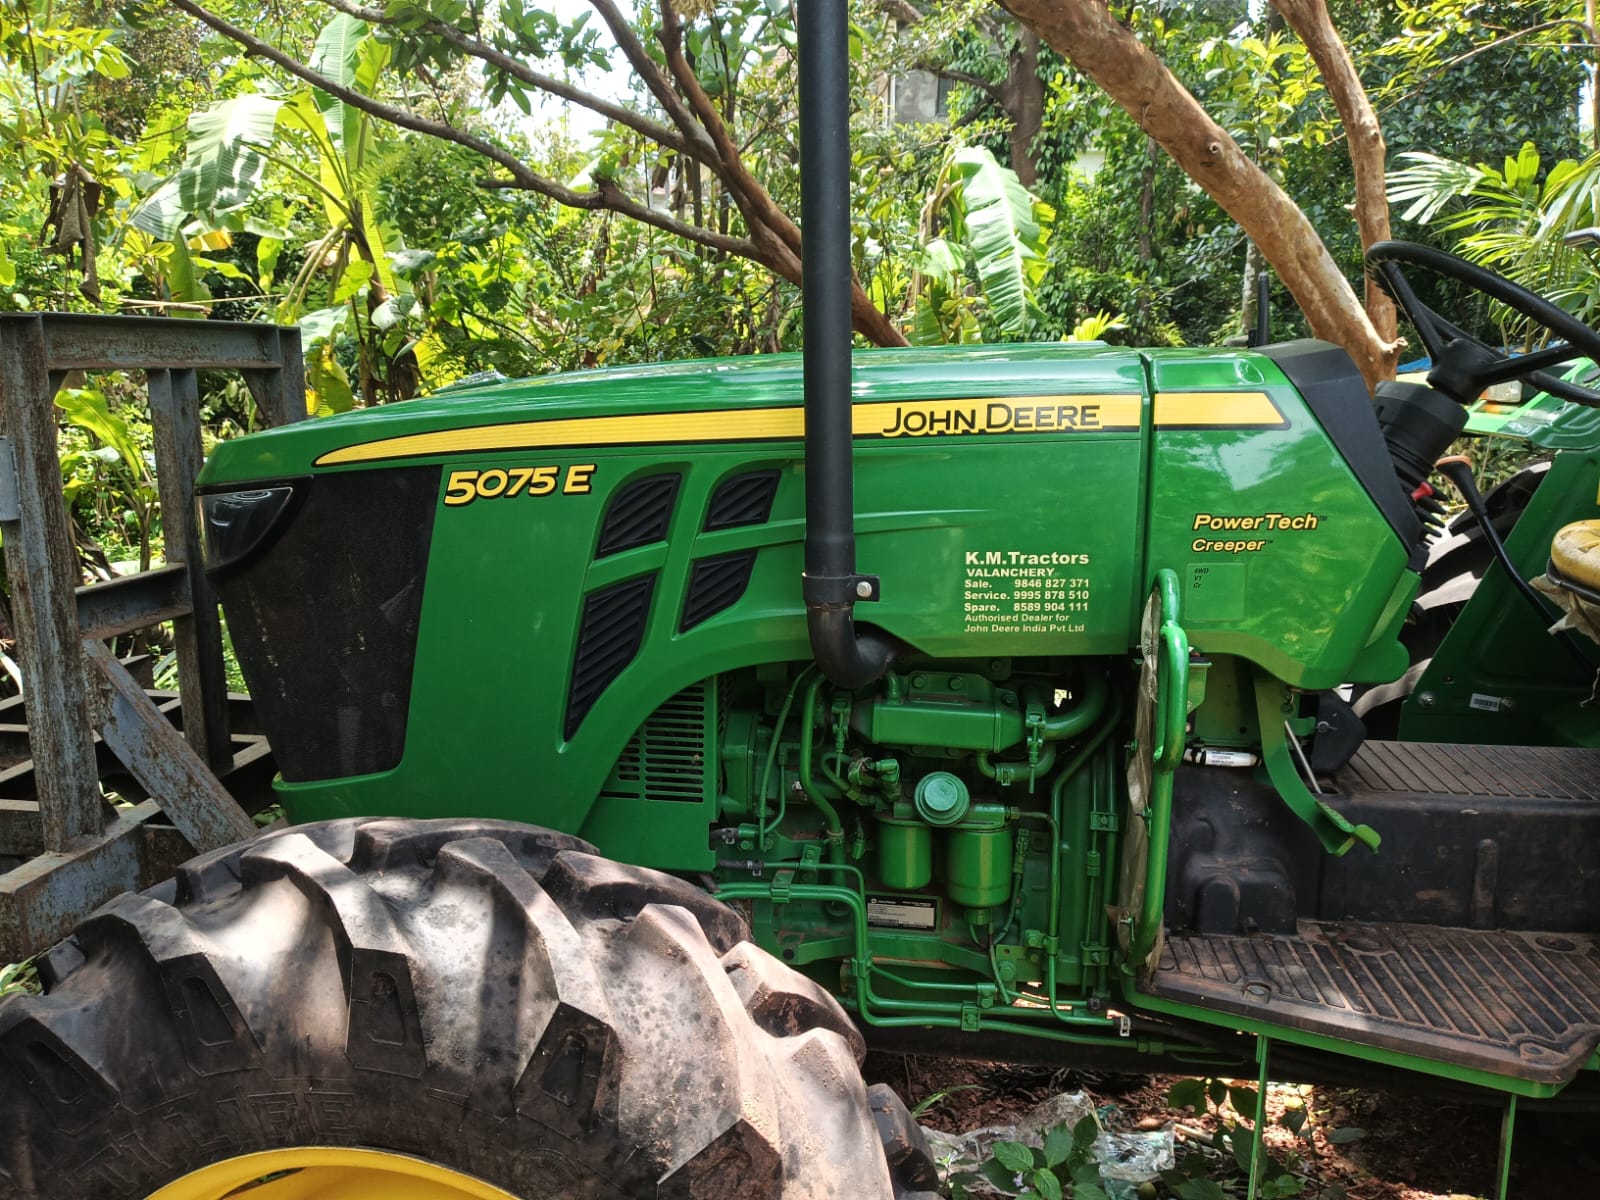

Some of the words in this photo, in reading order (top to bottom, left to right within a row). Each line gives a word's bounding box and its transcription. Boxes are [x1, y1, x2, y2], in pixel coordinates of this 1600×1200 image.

[883, 407, 976, 433] JOHN
[986, 404, 1100, 429] DEERE
[444, 465, 561, 507] 5075
[1193, 512, 1319, 531] PowerTech
[1192, 538, 1265, 554] Creeper
[966, 568, 1055, 577] VALANCHERY
[964, 579, 993, 588] Sale.
[1014, 579, 1042, 588] 9846
[1044, 579, 1066, 588] 827
[1069, 579, 1089, 588] 371
[964, 591, 1010, 600] Service.
[1013, 591, 1041, 600] 9995
[1044, 591, 1065, 600] 878
[1068, 591, 1089, 600] 510
[964, 602, 1000, 613] Spare.
[1013, 602, 1041, 612] 8589
[1044, 602, 1065, 612] 904
[1068, 602, 1089, 612] 111
[964, 614, 1019, 622] Authorised
[1021, 614, 1054, 622] Dealer
[1055, 614, 1070, 622] for
[964, 624, 989, 633] John
[991, 624, 1020, 633] Deere
[1022, 624, 1047, 633] India
[1049, 624, 1066, 633] Pvt
[1068, 624, 1085, 633] Ltd
